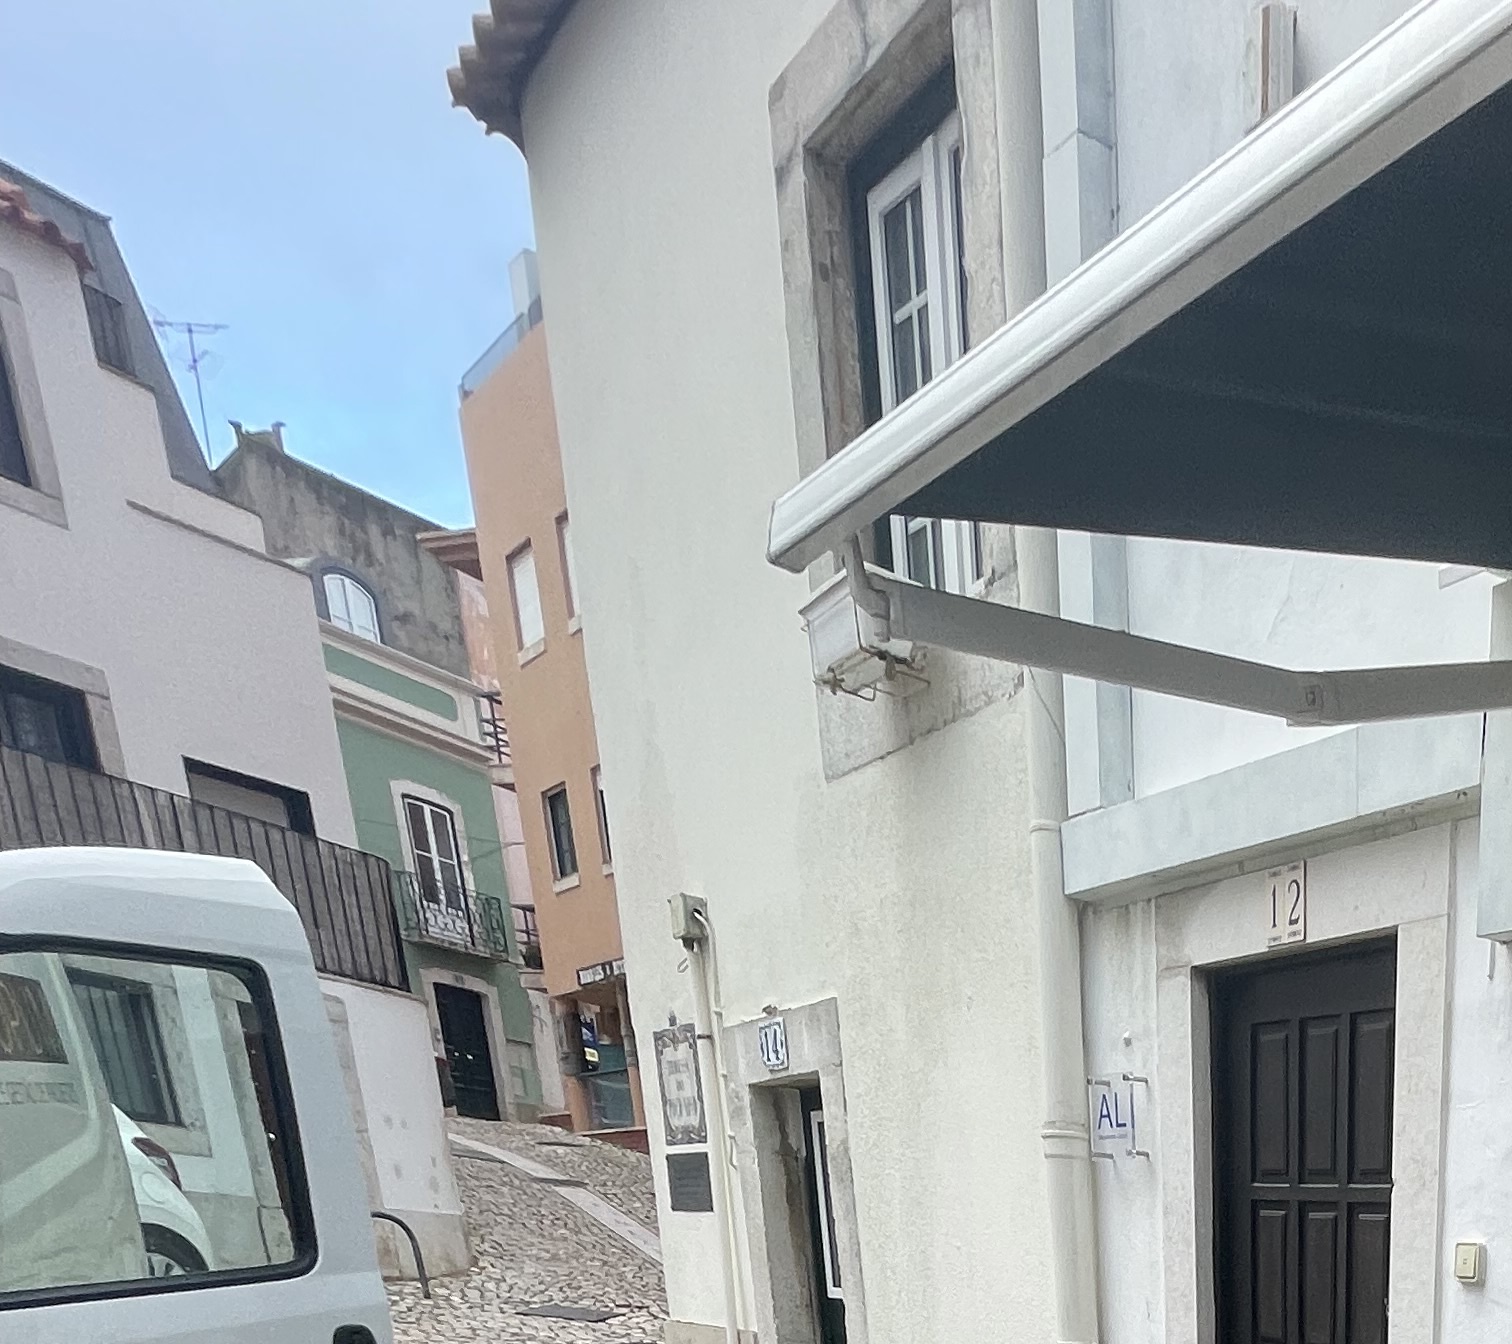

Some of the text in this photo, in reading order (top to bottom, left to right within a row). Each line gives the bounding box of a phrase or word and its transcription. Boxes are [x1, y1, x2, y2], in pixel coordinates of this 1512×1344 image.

[1271, 879, 1300, 928] 12
[765, 1028, 780, 1062] 14
[1098, 1092, 1127, 1130] AL
